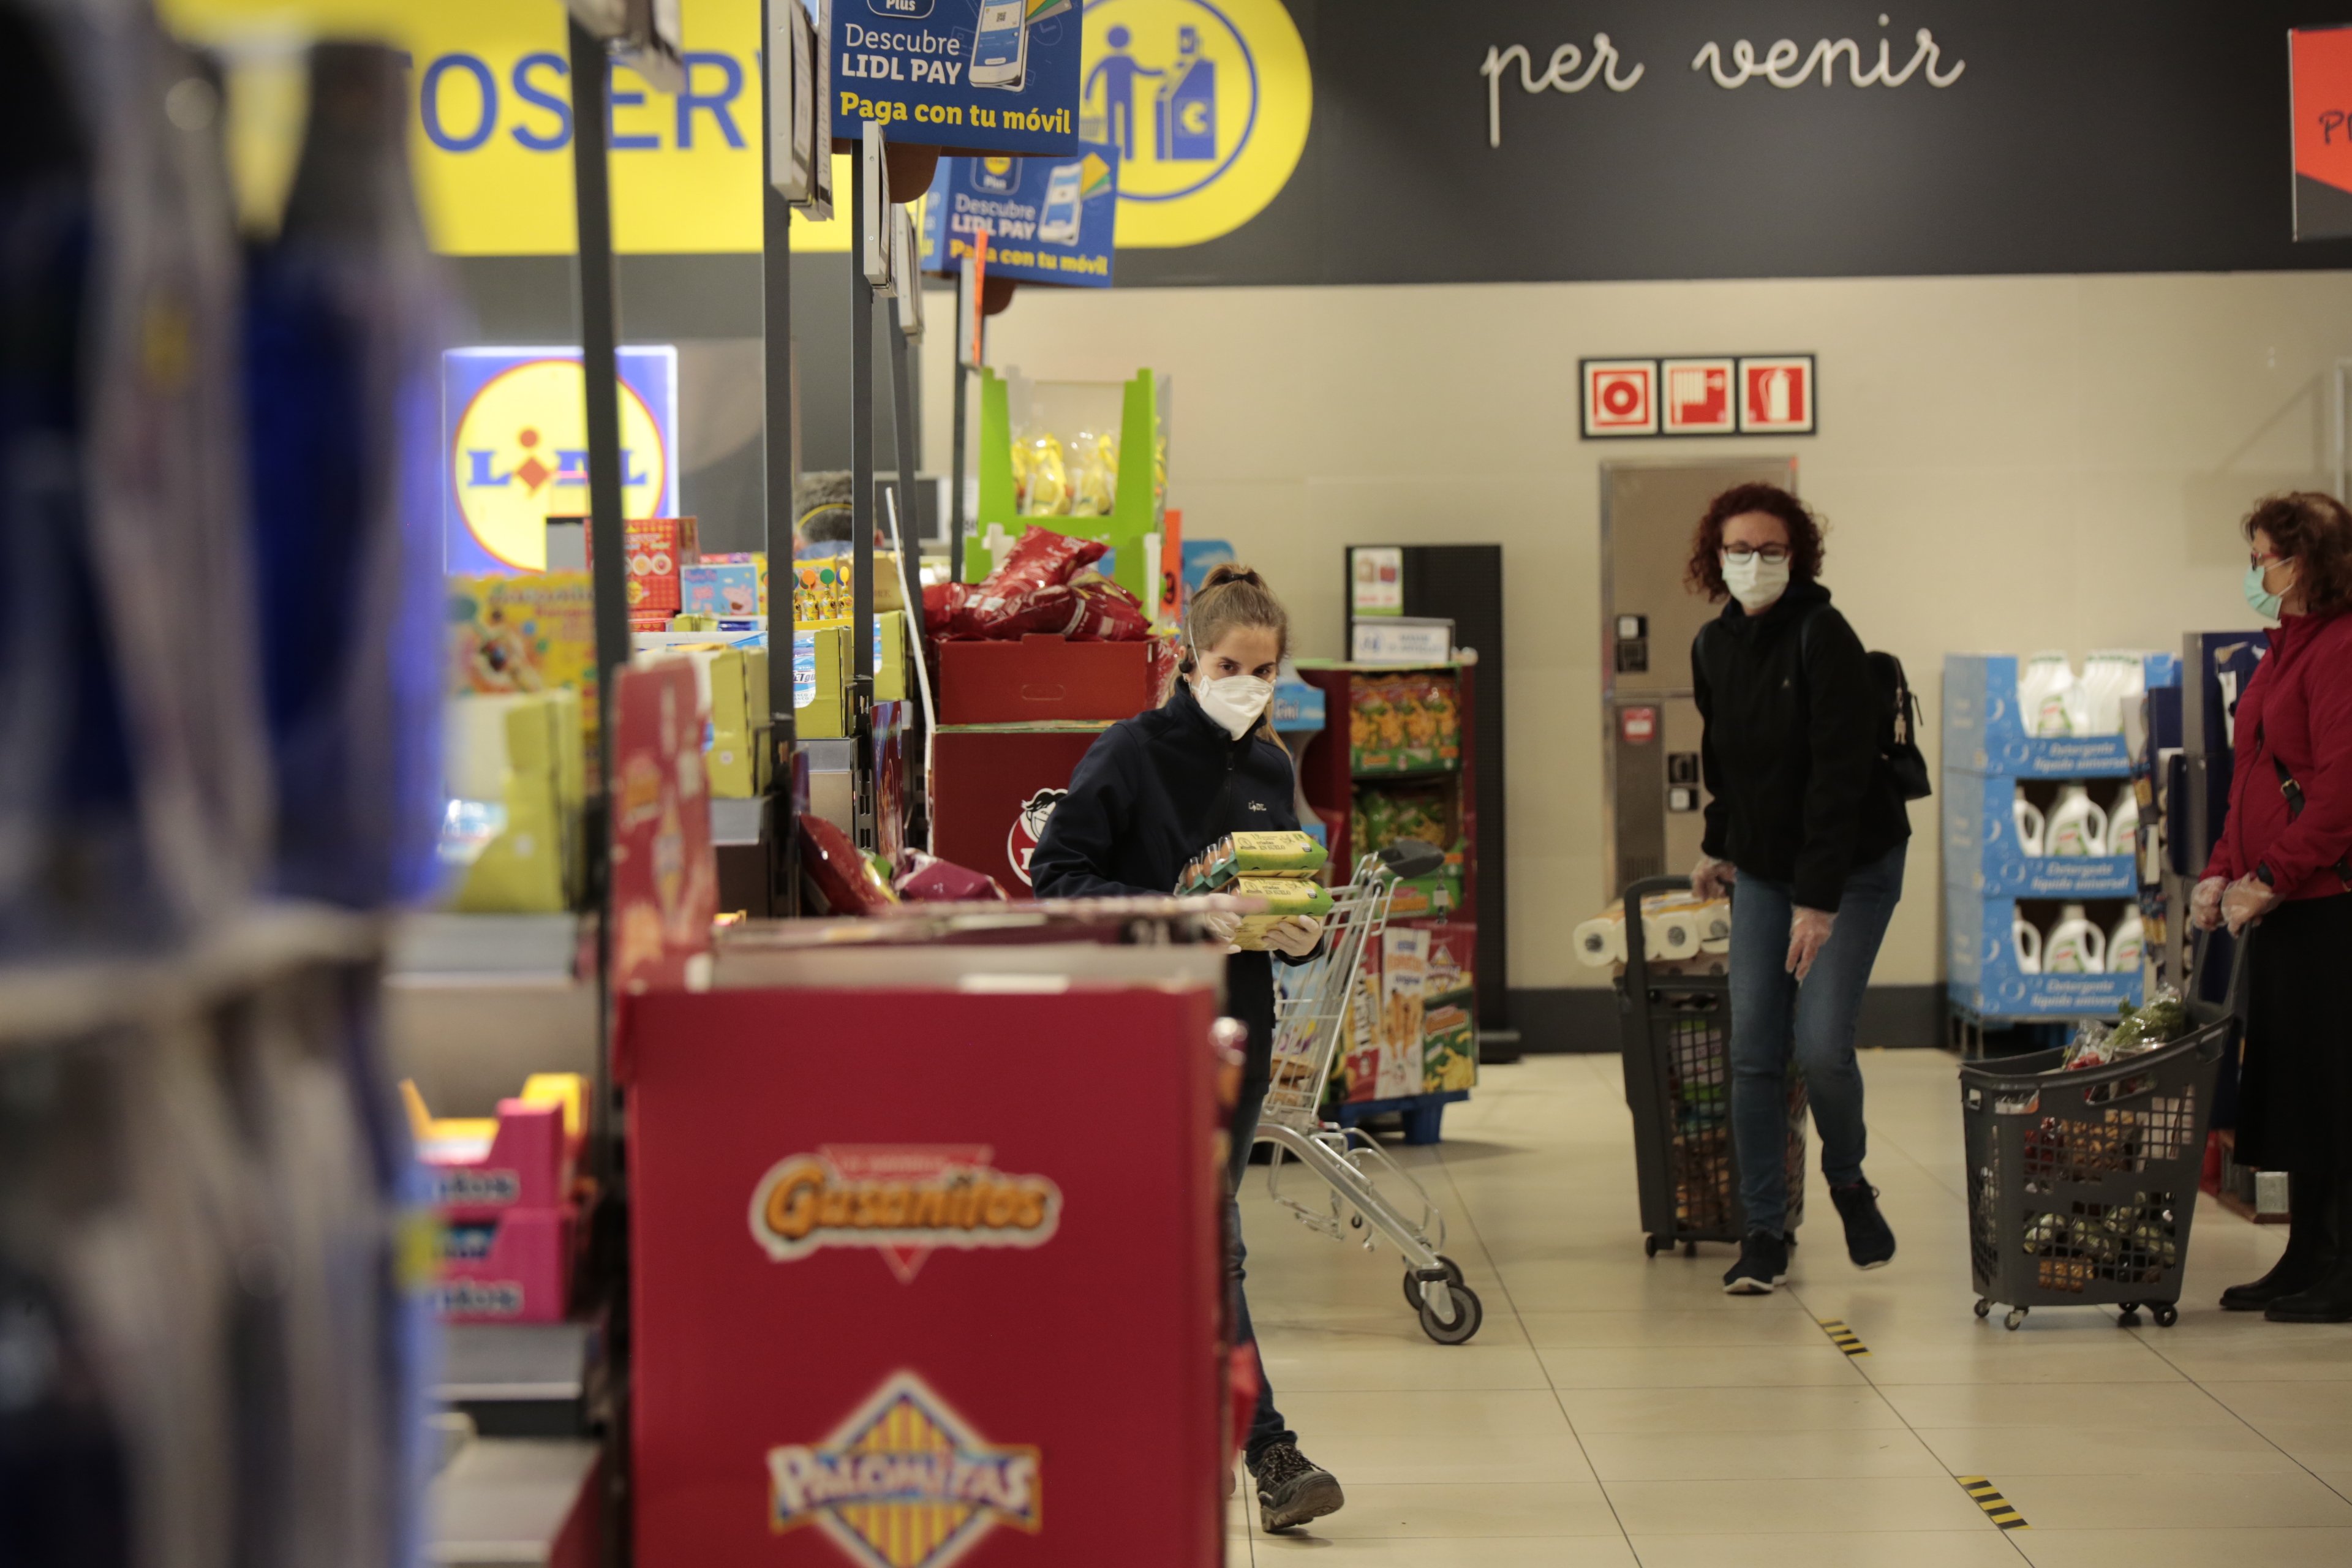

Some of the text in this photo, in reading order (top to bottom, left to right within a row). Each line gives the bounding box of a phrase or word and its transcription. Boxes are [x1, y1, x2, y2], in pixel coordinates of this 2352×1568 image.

[845, 23, 961, 56] Descubre
[842, 53, 962, 85] LIDL PAY
[1479, 13, 1966, 148] per venir
[840, 91, 1071, 134] Paga con tu móvil
[954, 193, 1036, 221] Descubre
[951, 213, 1036, 240] LIDL PAY
[949, 239, 1109, 276] Paa con tu móvil
